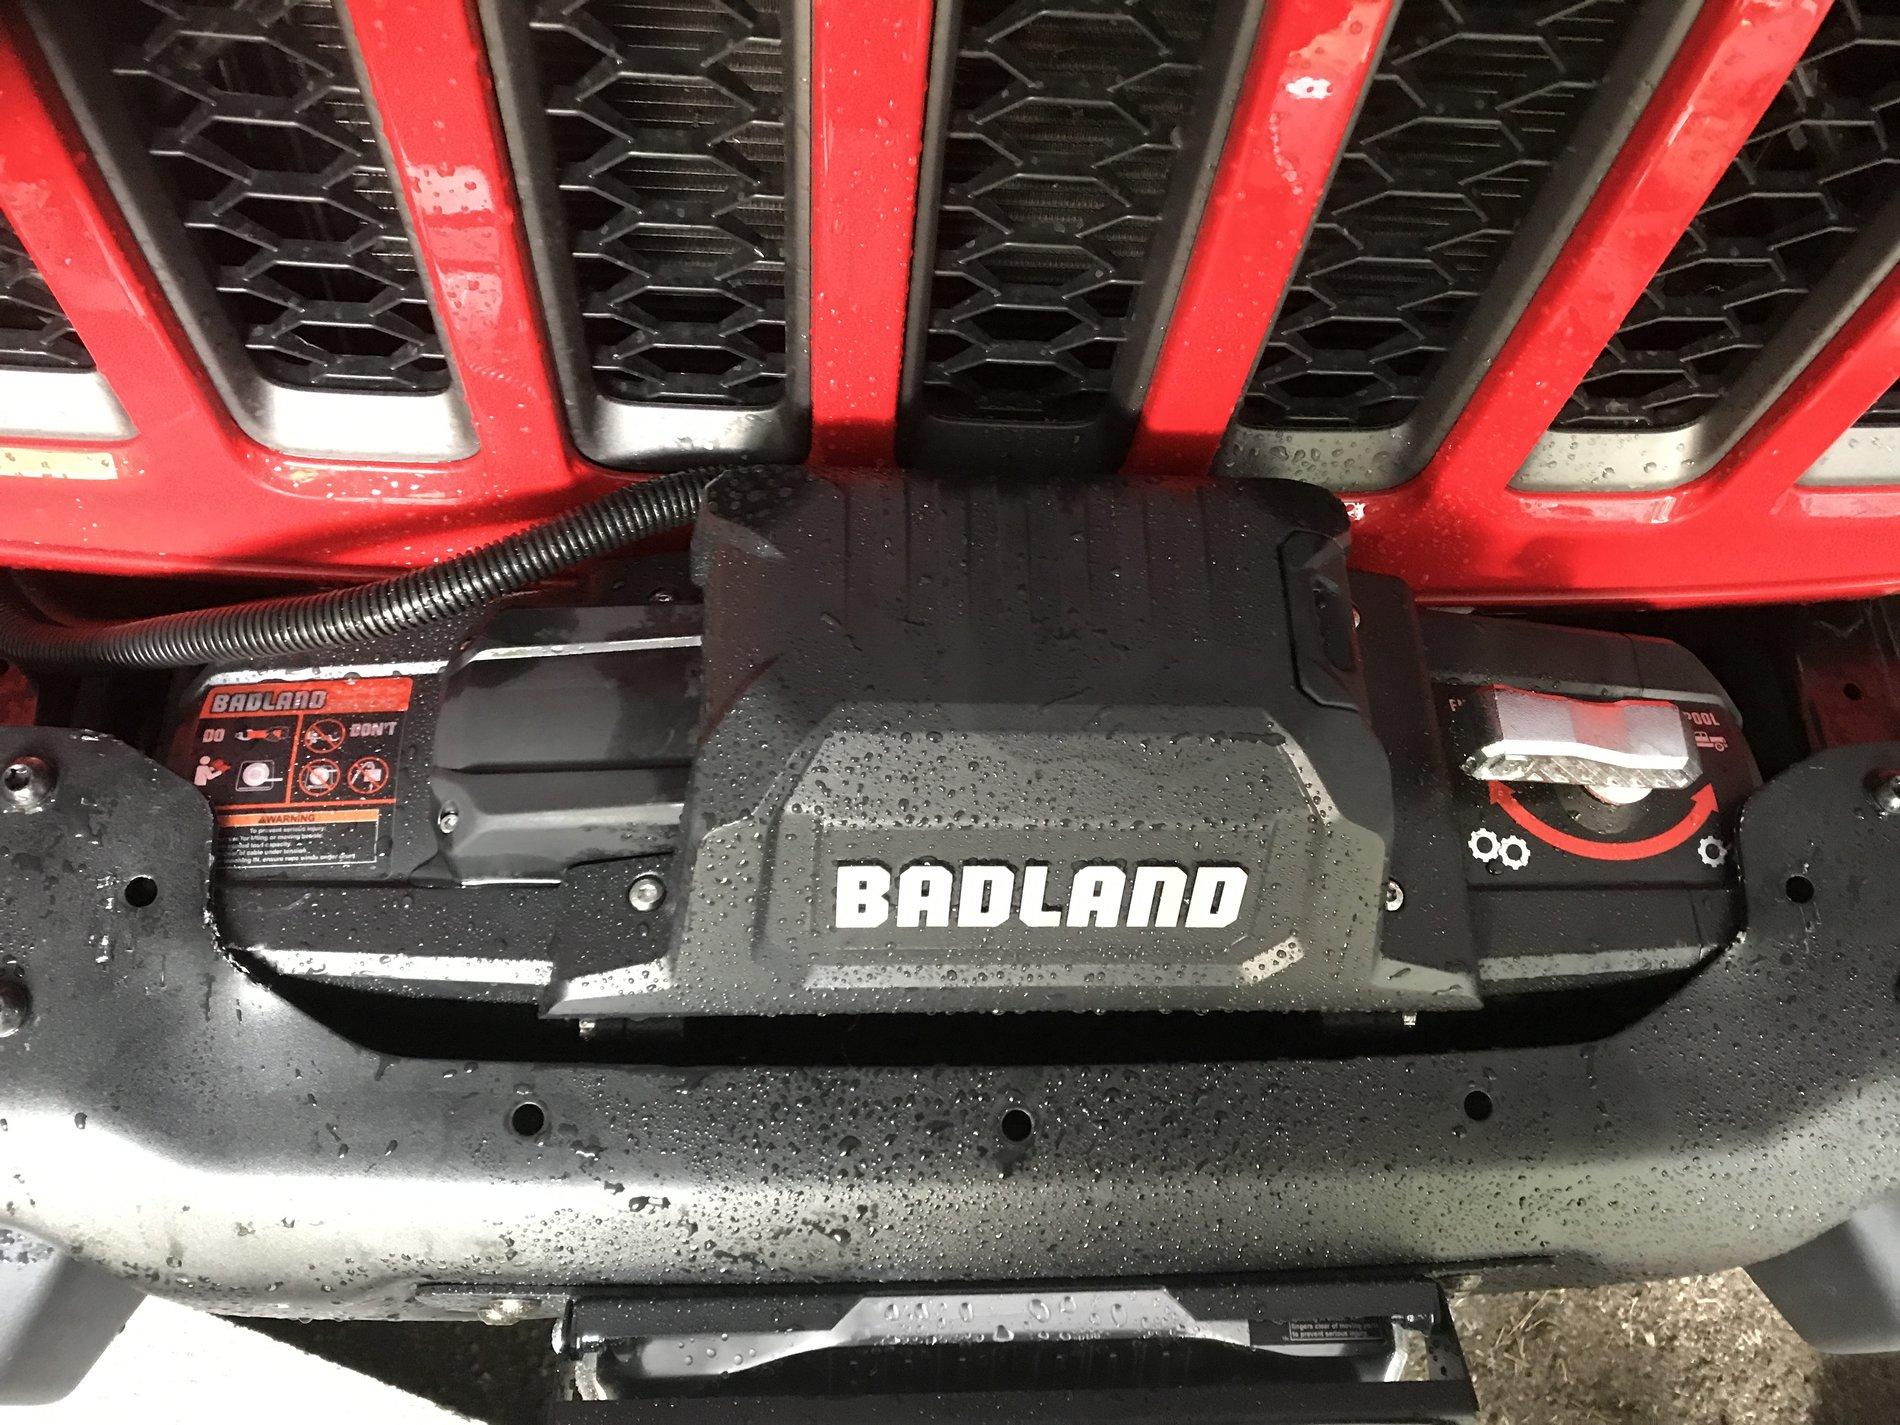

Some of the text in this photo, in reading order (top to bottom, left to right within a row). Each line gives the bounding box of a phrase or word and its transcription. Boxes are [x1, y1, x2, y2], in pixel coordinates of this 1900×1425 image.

[211, 690, 327, 713] BADLAND
[202, 728, 225, 743] DO
[350, 721, 398, 737] DON'T
[266, 814, 315, 823] WARNING
[835, 865, 1249, 929] BADLAND
[1300, 1331, 1324, 1339] prevent
[1325, 1330, 1348, 1338] serious
